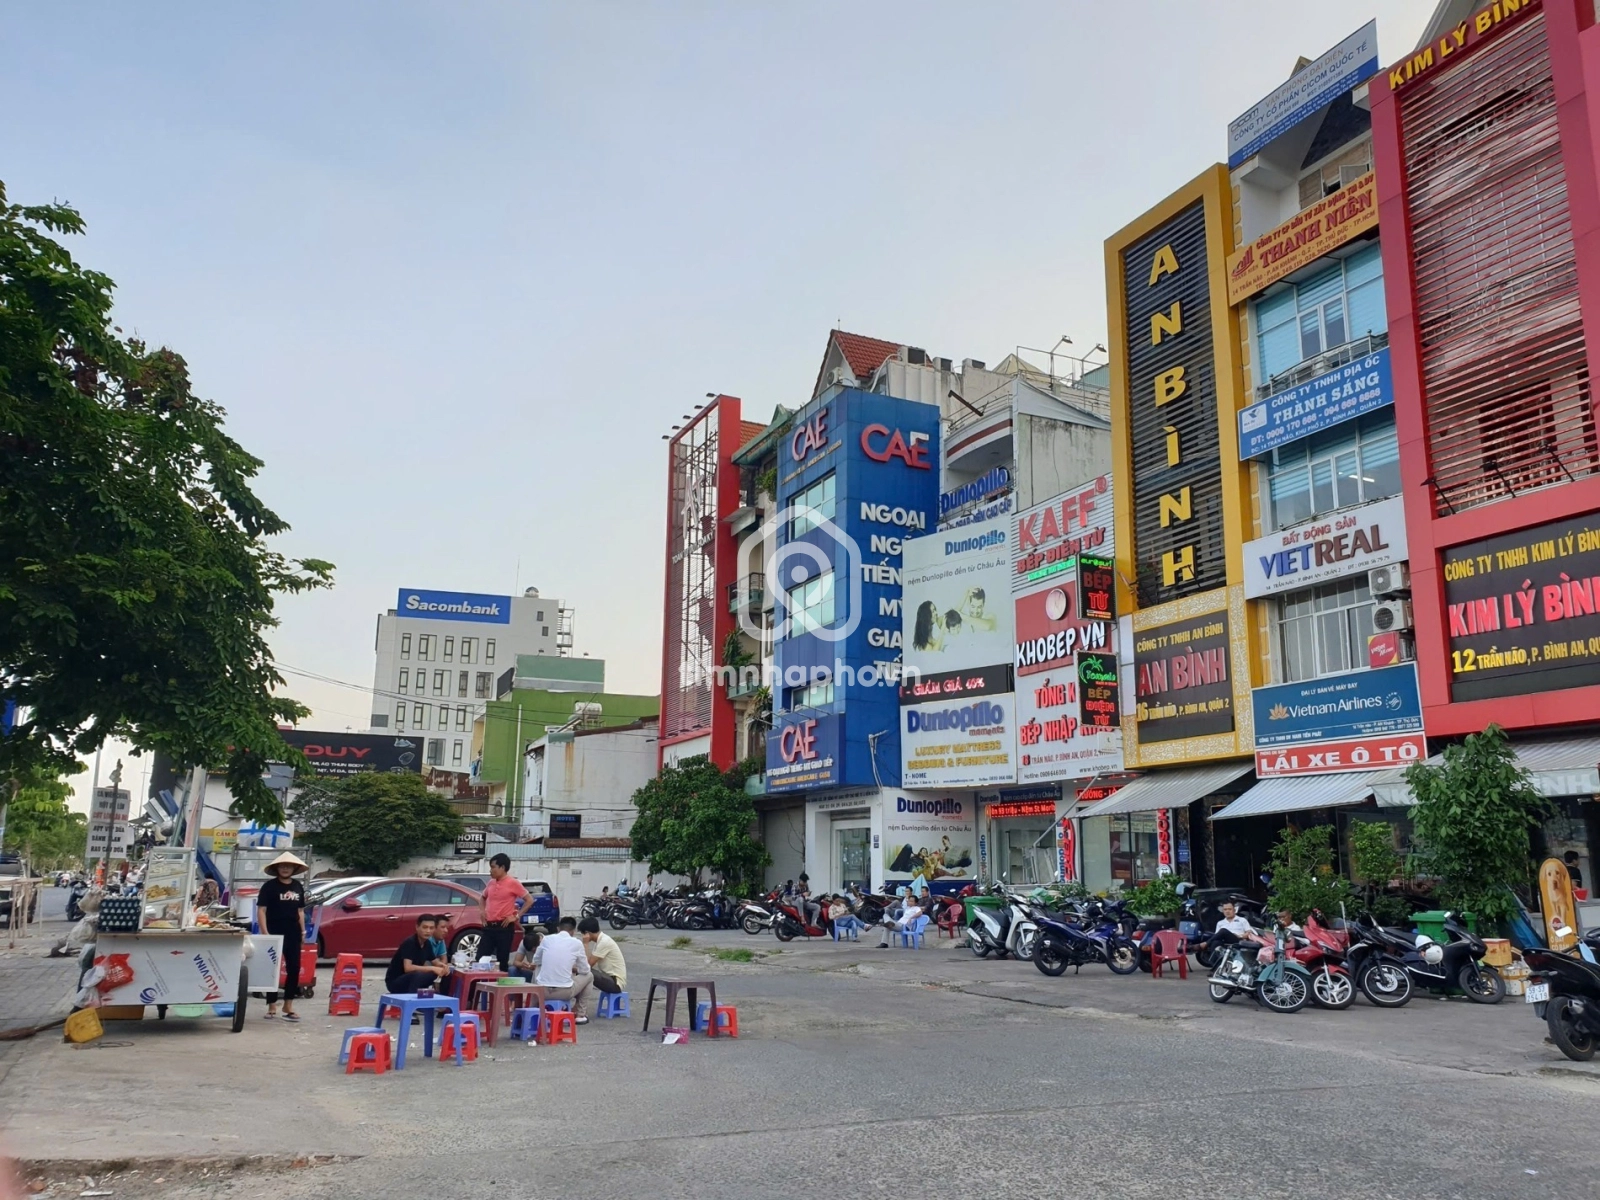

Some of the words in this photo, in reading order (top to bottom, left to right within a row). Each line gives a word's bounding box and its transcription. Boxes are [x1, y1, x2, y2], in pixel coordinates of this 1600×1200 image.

[1388, 47, 1433, 91] KIM
[1440, 20, 1469, 58] LÝ
[1475, 0, 1531, 34] BÌN
[1234, 122, 1254, 142] CÔNG
[1256, 111, 1266, 123] TY
[1301, 70, 1327, 93] CICOM
[1355, 39, 1368, 55] TẾ
[1260, 219, 1321, 269] THANH
[1325, 189, 1373, 232] NIÊN
[1271, 390, 1297, 408] CÔNG
[1298, 385, 1311, 397] TY
[1315, 373, 1341, 390] TNHH
[1344, 364, 1362, 379] ĐỊA
[1364, 355, 1380, 368] ỐC
[1273, 391, 1328, 425] THÀNH
[1332, 371, 1380, 402] SÁNG
[791, 408, 829, 464] CAE
[860, 422, 932, 471] CAE
[941, 467, 1008, 514] Dunlopillo
[1018, 487, 1096, 552] KAFF
[1282, 530, 1301, 546] BẤT
[1303, 524, 1332, 541] ĐỘNG
[1335, 515, 1357, 530] SẢN
[871, 533, 913, 556] NG
[944, 529, 1006, 556] Dunlopillo
[1017, 548, 1045, 574] BẾP
[1046, 540, 1082, 564] ĐIỆN
[1082, 527, 1106, 550] TỪ
[1445, 558, 1475, 582] CÔNG
[1477, 554, 1492, 574] TY
[1496, 546, 1529, 571] TNHH
[1532, 540, 1556, 563] KIM
[1559, 531, 1574, 556] LÝ
[861, 558, 904, 586] TIẾN
[922, 568, 953, 584] Dunlopillo
[976, 560, 994, 571] Châu
[996, 557, 1006, 567] Âu
[1083, 569, 1112, 590] BẾP
[406, 594, 501, 617] Sacombank
[1088, 590, 1109, 610] TỪ
[1449, 596, 1501, 638] KIM
[1503, 578, 1537, 629] LÝ
[868, 628, 903, 649] GIA
[1016, 627, 1077, 668] KHOBEP
[1137, 637, 1157, 653] CÔNG
[1157, 636, 1168, 648] TY
[1170, 630, 1191, 645] TNHH
[1192, 627, 1203, 640] AN
[1204, 620, 1224, 637] BÌNH
[873, 656, 903, 683] TIẾ
[1138, 659, 1169, 697] AN
[1172, 646, 1227, 690] BÌNH
[1452, 648, 1478, 674] 12
[1477, 645, 1505, 669] TRẦN
[1532, 647, 1542, 662] P.
[1544, 640, 1568, 660] BÌNH
[1570, 639, 1589, 657] AN,
[1034, 677, 1066, 709] TỔNG
[1088, 686, 1111, 699] BẾP
[1289, 703, 1337, 718] Vietnam
[1337, 695, 1382, 711] Airlines
[907, 700, 1005, 734] Dunlopillo
[1093, 714, 1110, 726] TỪ
[1136, 702, 1149, 721] 16
[780, 719, 818, 763] CAE
[1020, 717, 1043, 746] BẾP
[1043, 714, 1078, 744] NHẬP
[303, 744, 371, 758] DUY
[915, 744, 952, 757] LUXURY
[952, 740, 1002, 754] MATTRESS
[947, 757, 954, 767] &
[956, 753, 1009, 767] FURNITURE
[1260, 753, 1298, 772] LÁI
[1308, 751, 1341, 767] XE
[1350, 746, 1370, 764] Ô
[1379, 740, 1419, 762] TÔ
[897, 797, 962, 816] Dunlopillo
[457, 834, 484, 842] HOTEL
[901, 823, 930, 833] Dunlopillo
[949, 823, 963, 831] Châu
[964, 823, 971, 832] Âu
[1158, 807, 1170, 865] BOSCH
[280, 891, 300, 901] LOVE
[193, 954, 223, 1001] ALUVINA
